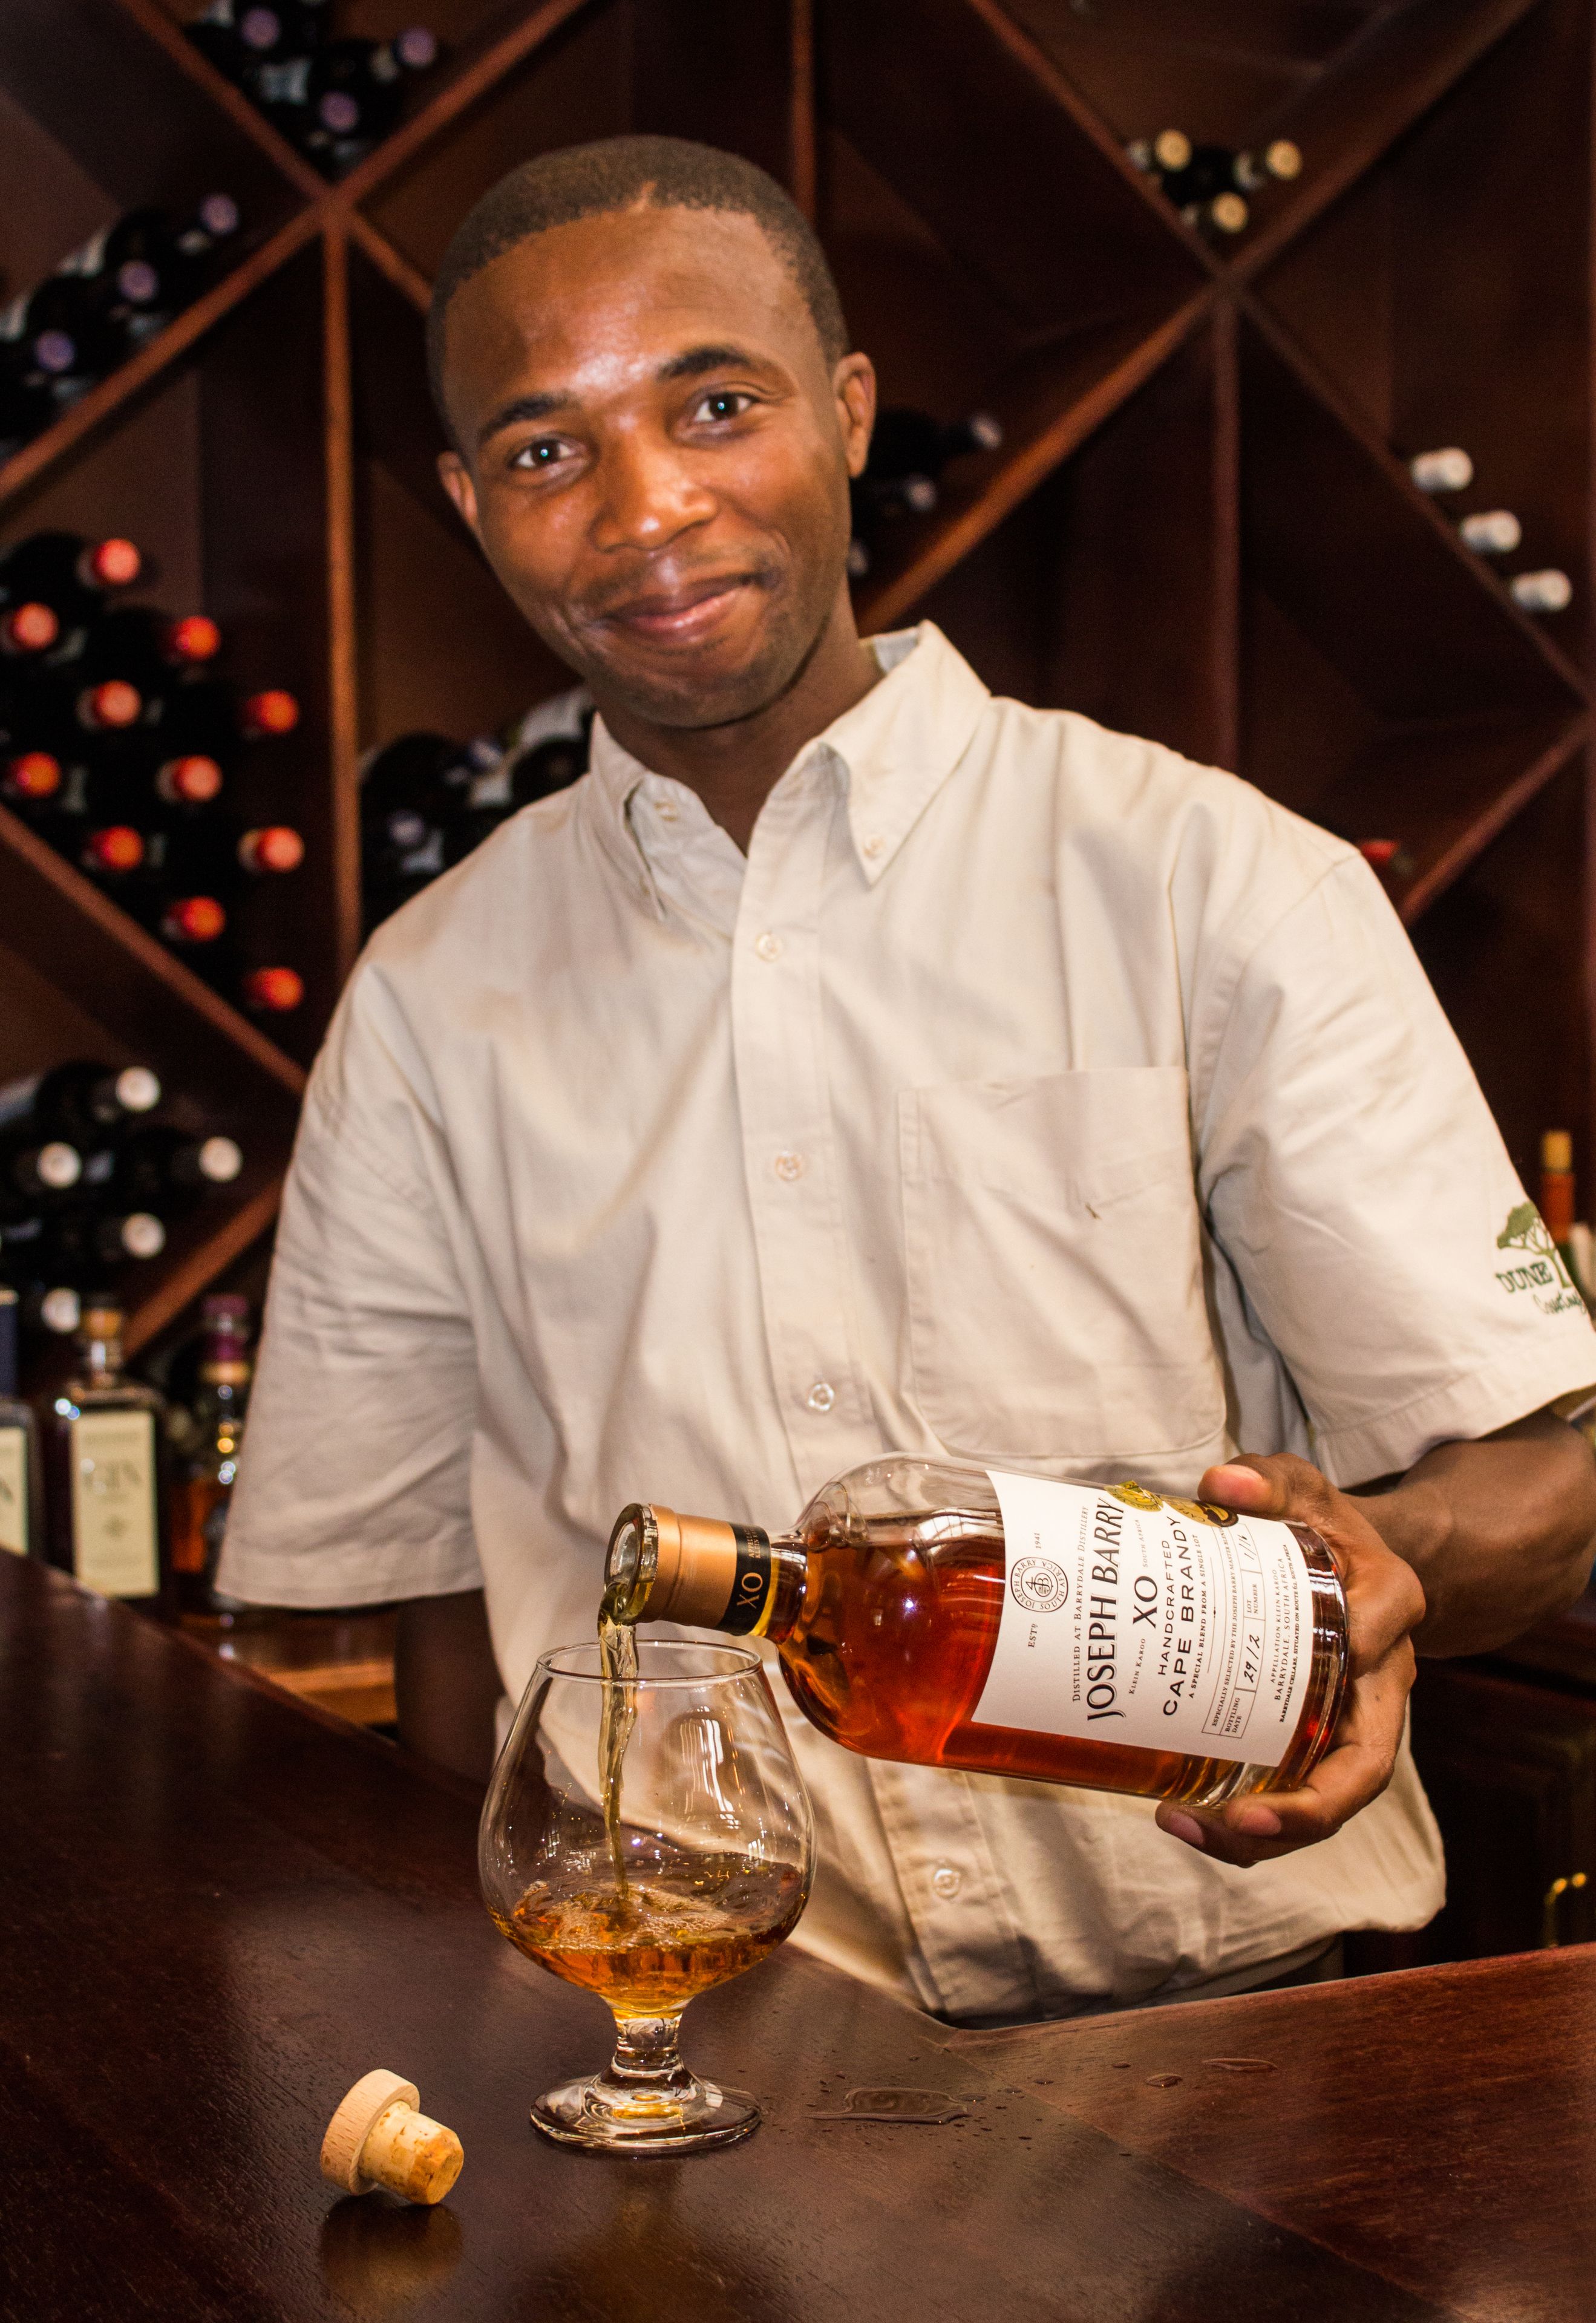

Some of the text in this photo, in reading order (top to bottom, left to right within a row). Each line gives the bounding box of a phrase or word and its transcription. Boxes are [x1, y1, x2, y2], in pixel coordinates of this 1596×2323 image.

[1495, 1261, 1554, 1293] DUNE
[1134, 1519, 1145, 1541] AFRICA
[1192, 1534, 1201, 1547] LOT
[1042, 1561, 1065, 1587] AFRICA
[1166, 1516, 1194, 1622] BRANDY
[1197, 1549, 1206, 1577] SINGLE
[1227, 1546, 1235, 1572] MASTER
[1278, 1558, 1289, 1590] AFRICA
[736, 1572, 763, 1609] XO
[1014, 1560, 1036, 1608] JOSEPH BARRY
[1040, 1590, 1065, 1610] SOUTH
[1272, 1569, 1281, 1596] KAROO
[1072, 1506, 1088, 1702] DISTILLED AT BARRYDALE DISTILLERY
[1087, 1497, 1126, 1721] JOSEPH BARRY
[1133, 1576, 1158, 1629] XO
[1157, 1540, 1174, 1675] HANDCRAFTED
[1128, 1638, 1146, 1694] KLEIN KAROO
[1191, 1652, 1203, 1688] SPECIAL
[1225, 1650, 1234, 1685] SELECTED
[1271, 1625, 1281, 1684] APPELLATION
[1280, 1686, 1293, 1723] BARRYDALE
[1295, 1613, 1300, 1622] ON
[1163, 1638, 1192, 1716] CAPE
[1212, 1686, 1228, 1727] ESPECIALLY
[1225, 1697, 1240, 1733] BOTTLING
[1232, 1715, 1242, 1733] DATE
